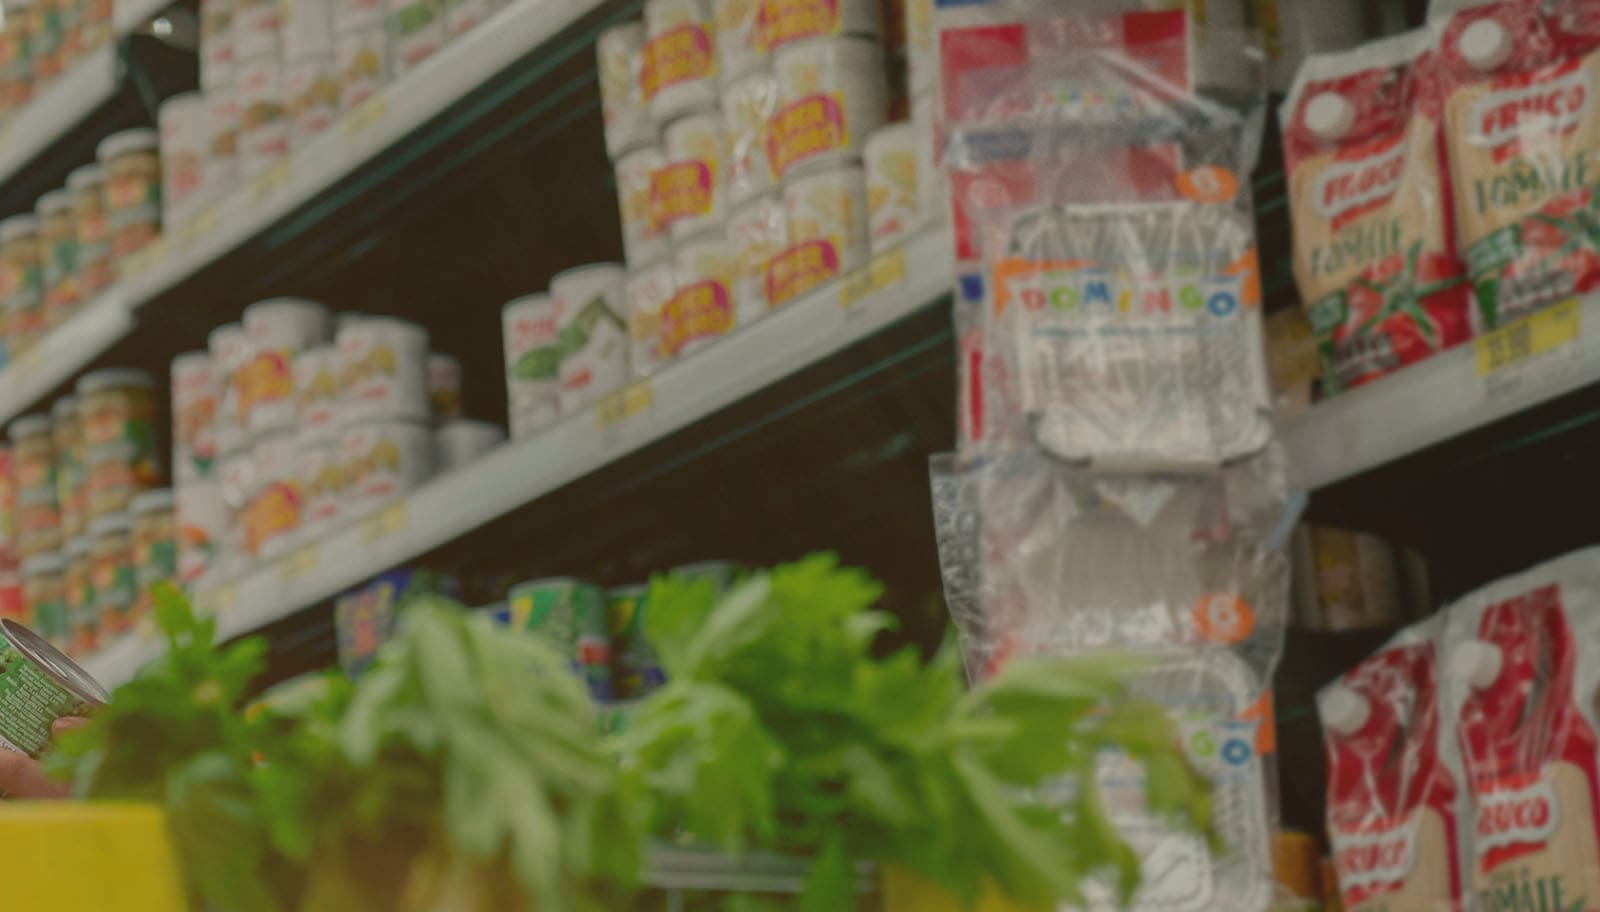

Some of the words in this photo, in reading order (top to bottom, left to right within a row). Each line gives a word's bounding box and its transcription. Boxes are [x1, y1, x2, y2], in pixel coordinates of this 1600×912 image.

[1019, 281, 1236, 317] DOMINGO
[1209, 599, 1238, 628] 6
[1476, 795, 1549, 836] RUCO
